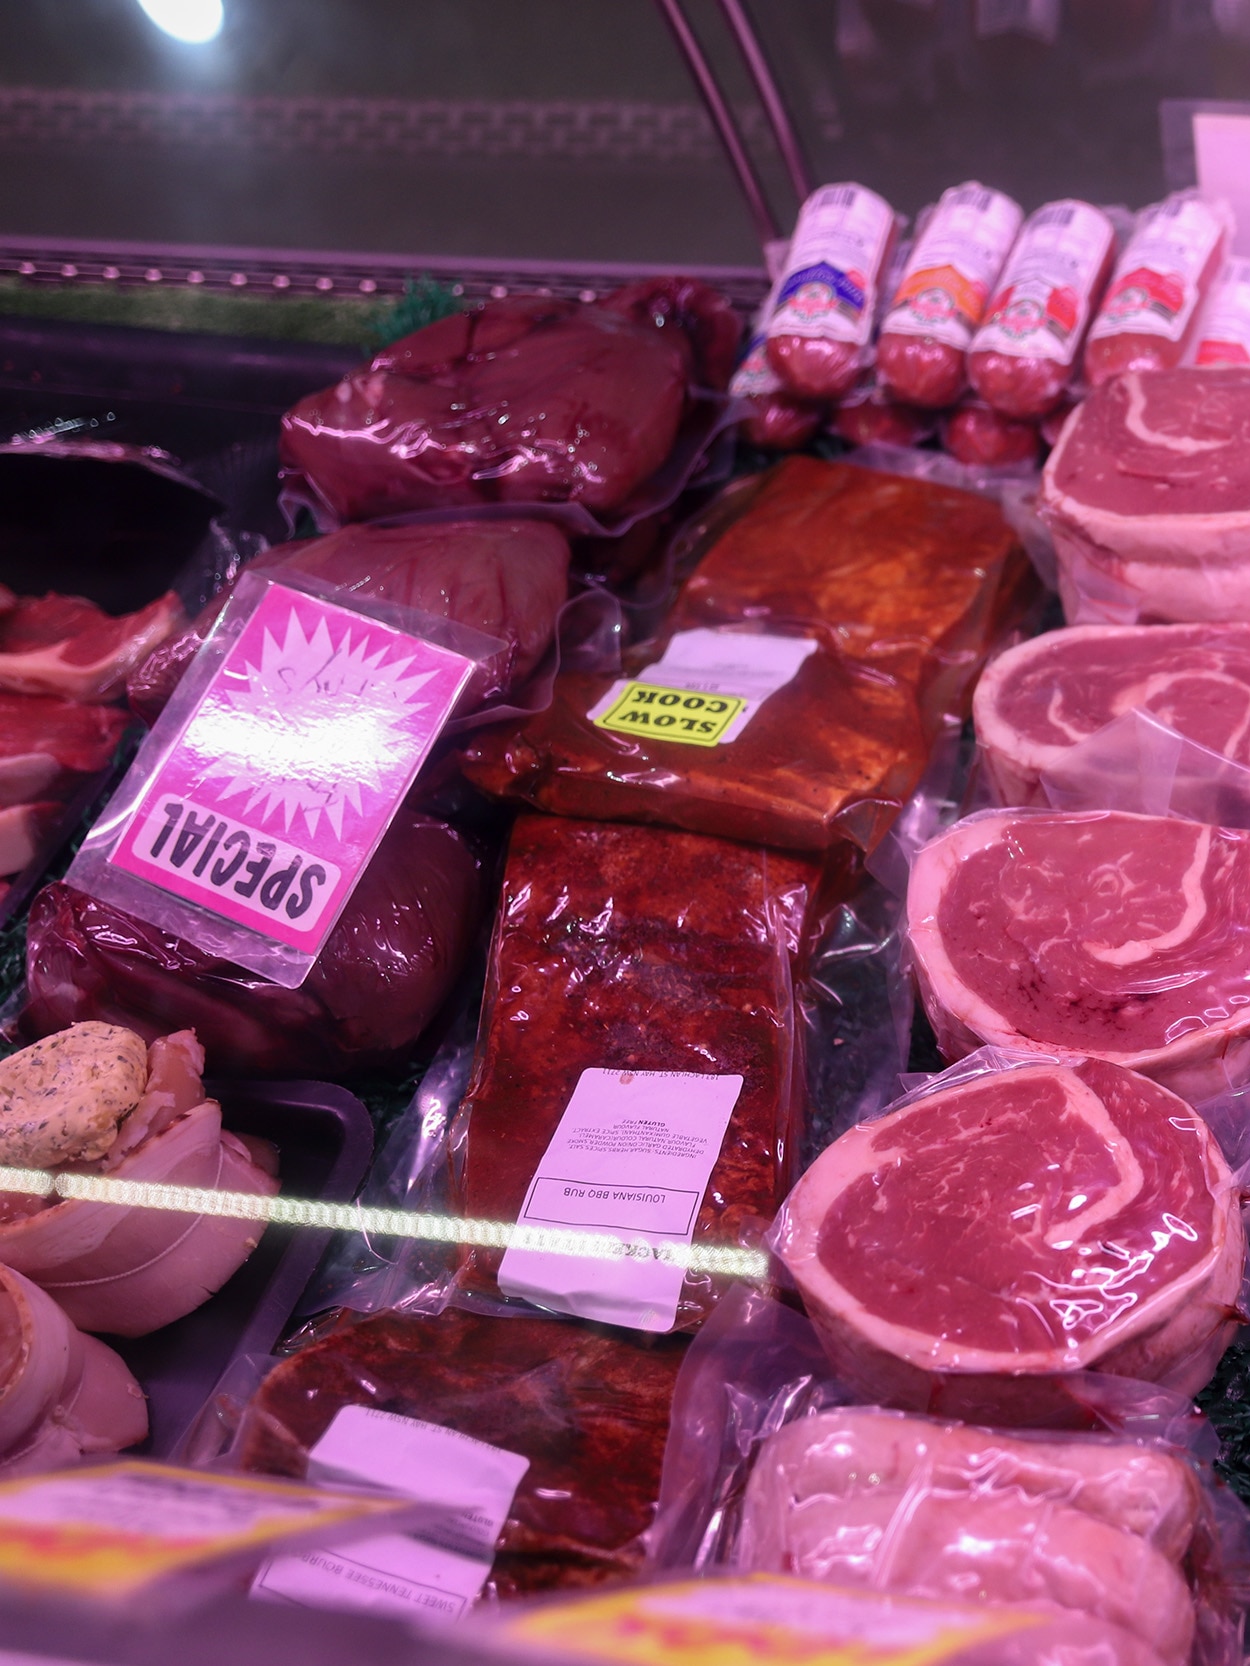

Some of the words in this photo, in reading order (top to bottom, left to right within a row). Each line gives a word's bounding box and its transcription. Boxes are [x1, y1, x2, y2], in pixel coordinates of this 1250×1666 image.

[631, 690, 728, 714] COOK
[618, 710, 717, 734] SLOW
[150, 800, 327, 919] SPECIAL
[639, 1119, 666, 1127] GLUTEN
[642, 1125, 669, 1133] NATURAL
[672, 1134, 708, 1144] VEGETABLE
[662, 1144, 705, 1155] DEHYDRATED
[563, 1187, 586, 1198] RUB
[588, 1188, 610, 1199] BBQ
[612, 1191, 666, 1204] LOUISIANA
[301, 1552, 344, 1575] BOURB
[344, 1569, 412, 1600] TENNESSEE
[412, 1592, 455, 1613] SWEET
